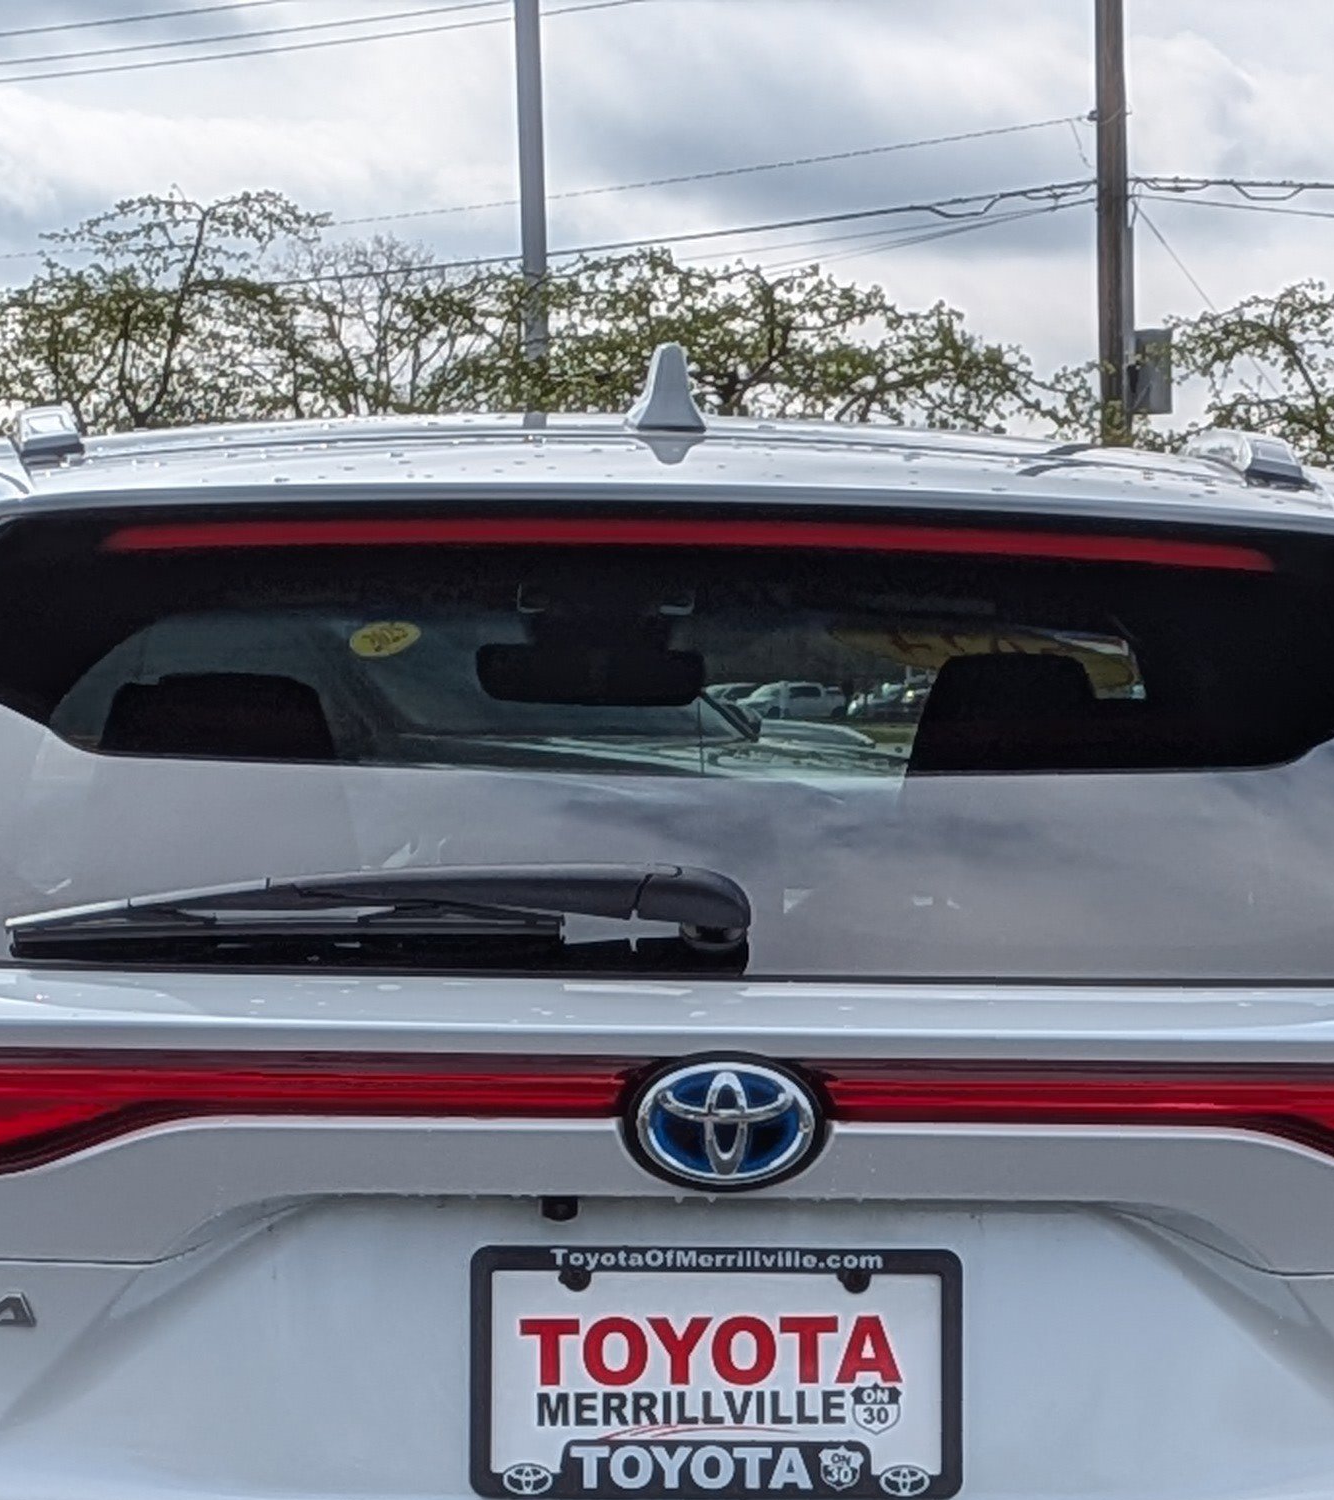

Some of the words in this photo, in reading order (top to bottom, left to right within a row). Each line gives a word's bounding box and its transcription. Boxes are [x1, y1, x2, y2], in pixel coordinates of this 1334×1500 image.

[550, 1248, 884, 1271] ToyotaOfMerrillville.com
[519, 1315, 903, 1386] TOYOTA
[862, 1388, 890, 1404] ON
[537, 1389, 847, 1427] MERRILLVILLE
[863, 1406, 889, 1424] 30
[570, 1445, 814, 1490] TOYOTA
[827, 1467, 853, 1483] 30
